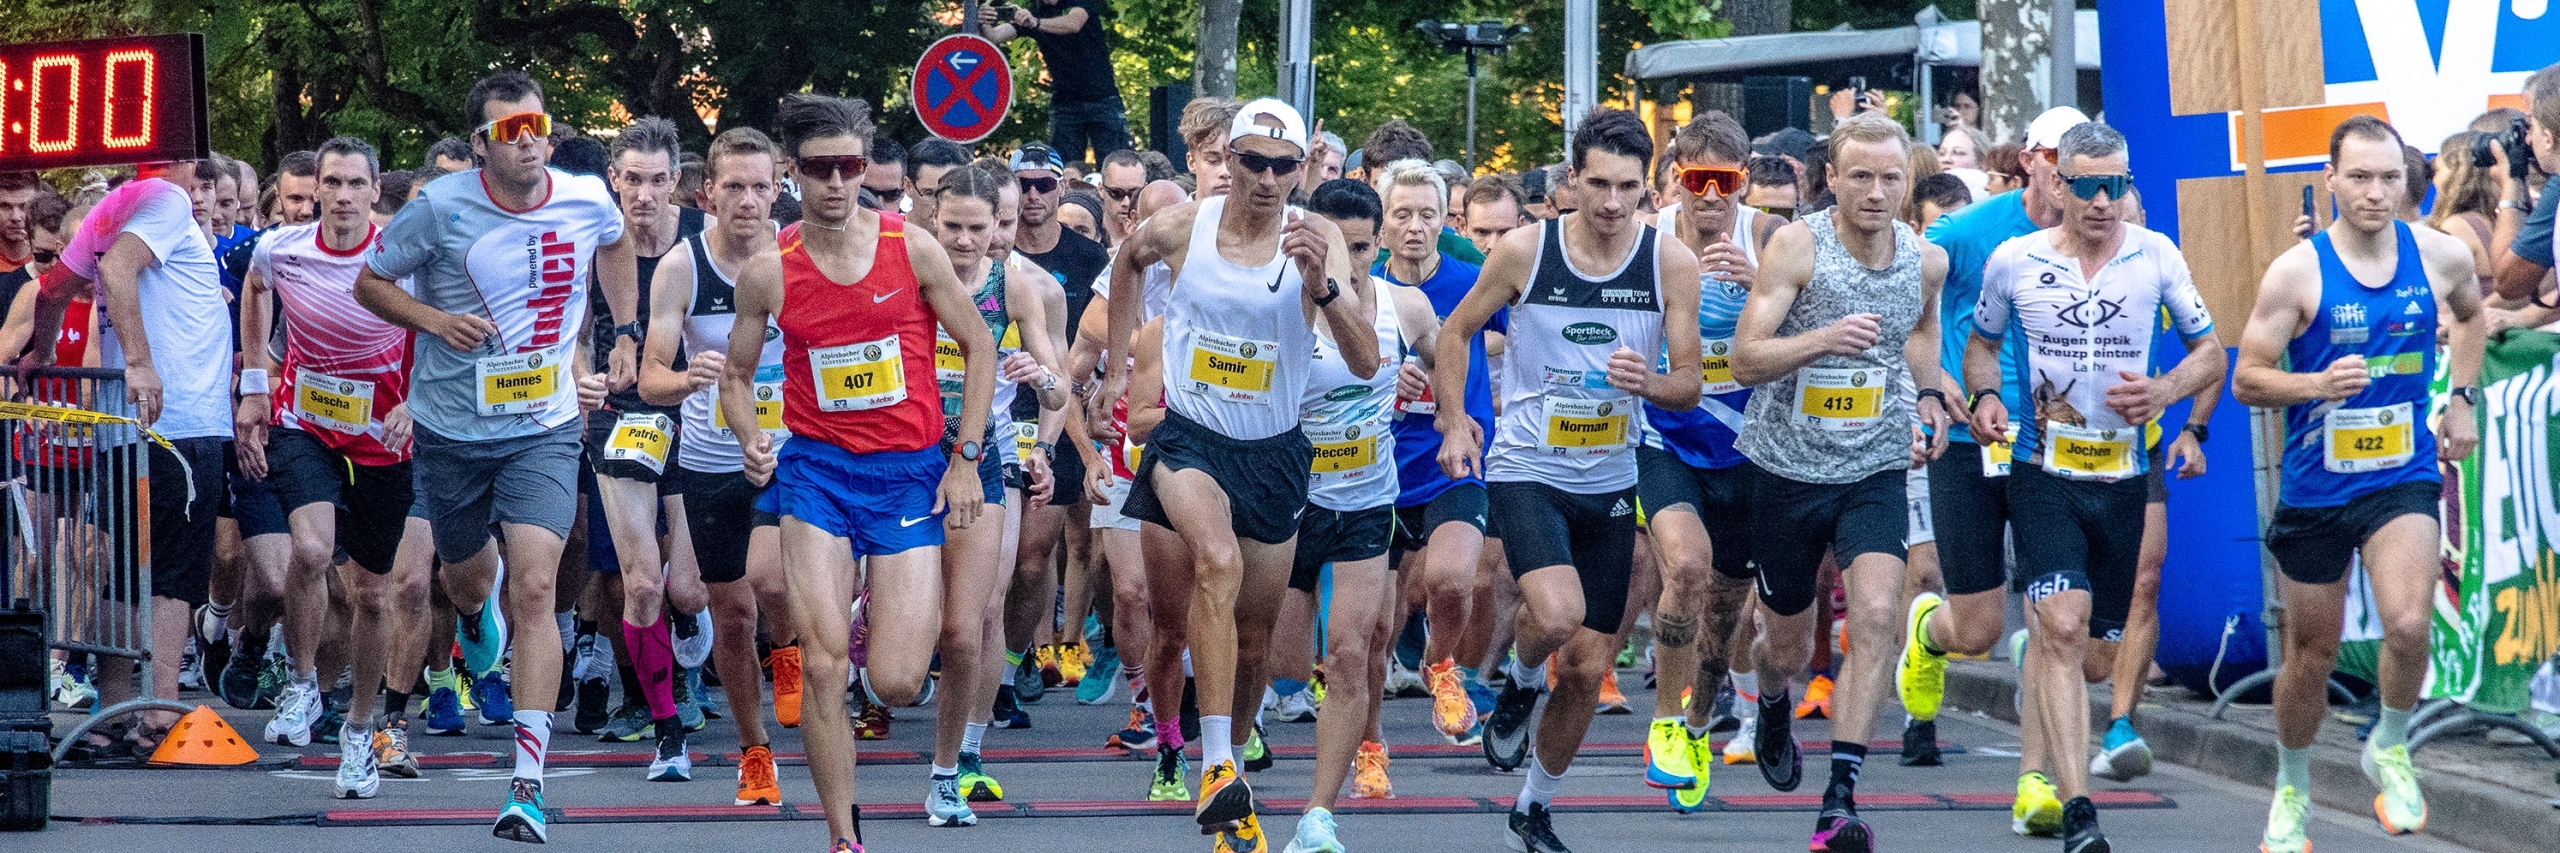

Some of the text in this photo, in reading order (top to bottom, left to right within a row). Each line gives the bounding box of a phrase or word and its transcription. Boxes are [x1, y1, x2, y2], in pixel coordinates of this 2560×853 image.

[0, 50, 154, 154] :00
[527, 235, 539, 288] powered by
[1602, 296, 1650, 304] ORTENAU
[1633, 290, 1650, 298] TEAM
[1565, 325, 1612, 336] SportBeck
[1198, 334, 1237, 349] Alpirsbacher
[820, 350, 860, 360] Alpirsbacher
[486, 358, 525, 369] Alpirsbacher
[1208, 355, 1248, 375] Samir
[1544, 365, 1583, 376] Trautmann
[496, 374, 542, 389] Hannes
[843, 372, 874, 390] 407
[1221, 376, 1228, 385] 5
[310, 390, 350, 410] Sascha
[512, 390, 528, 400] 154
[1553, 402, 1595, 410] Alpirsbacher
[1823, 396, 1854, 411] 413
[324, 409, 334, 417] 12
[1559, 419, 1609, 433] Norman
[627, 427, 660, 443] Patric
[635, 441, 645, 449] 15
[1580, 437, 1587, 446] 3
[2353, 435, 2384, 451] 422
[1313, 445, 1359, 459] Reccep
[2066, 442, 2112, 457] Jochen
[1333, 462, 1340, 470] 6
